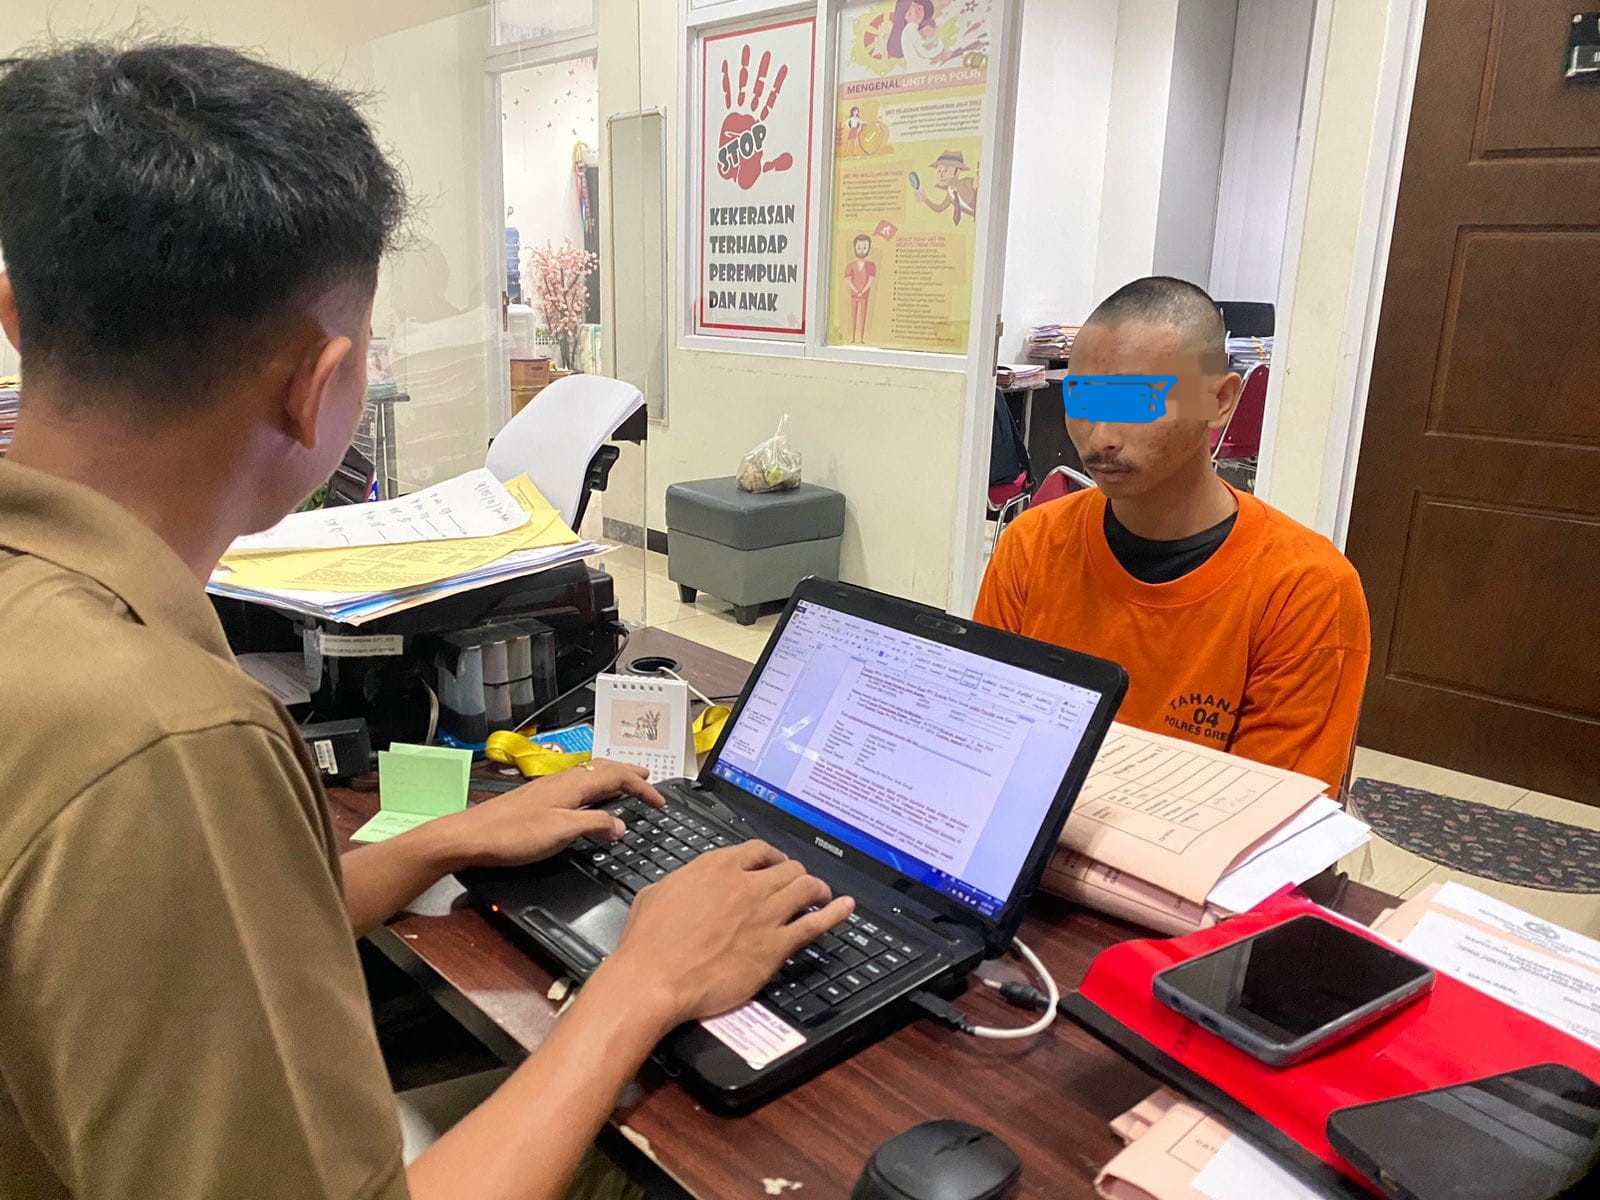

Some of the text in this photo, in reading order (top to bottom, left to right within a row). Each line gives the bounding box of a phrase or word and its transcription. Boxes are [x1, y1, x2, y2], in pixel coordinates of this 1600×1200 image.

[847, 78, 900, 94] MENGENAL
[902, 75, 926, 88] UNIT
[718, 124, 767, 173] STOP
[709, 204, 795, 226] KEKERASAN
[709, 234, 788, 254] TERHADAP
[709, 263, 798, 284] PEREMPUAN
[708, 291, 778, 312] DAN ANAK
[1164, 714, 1201, 735] POLRES
[1193, 707, 1219, 728] 04
